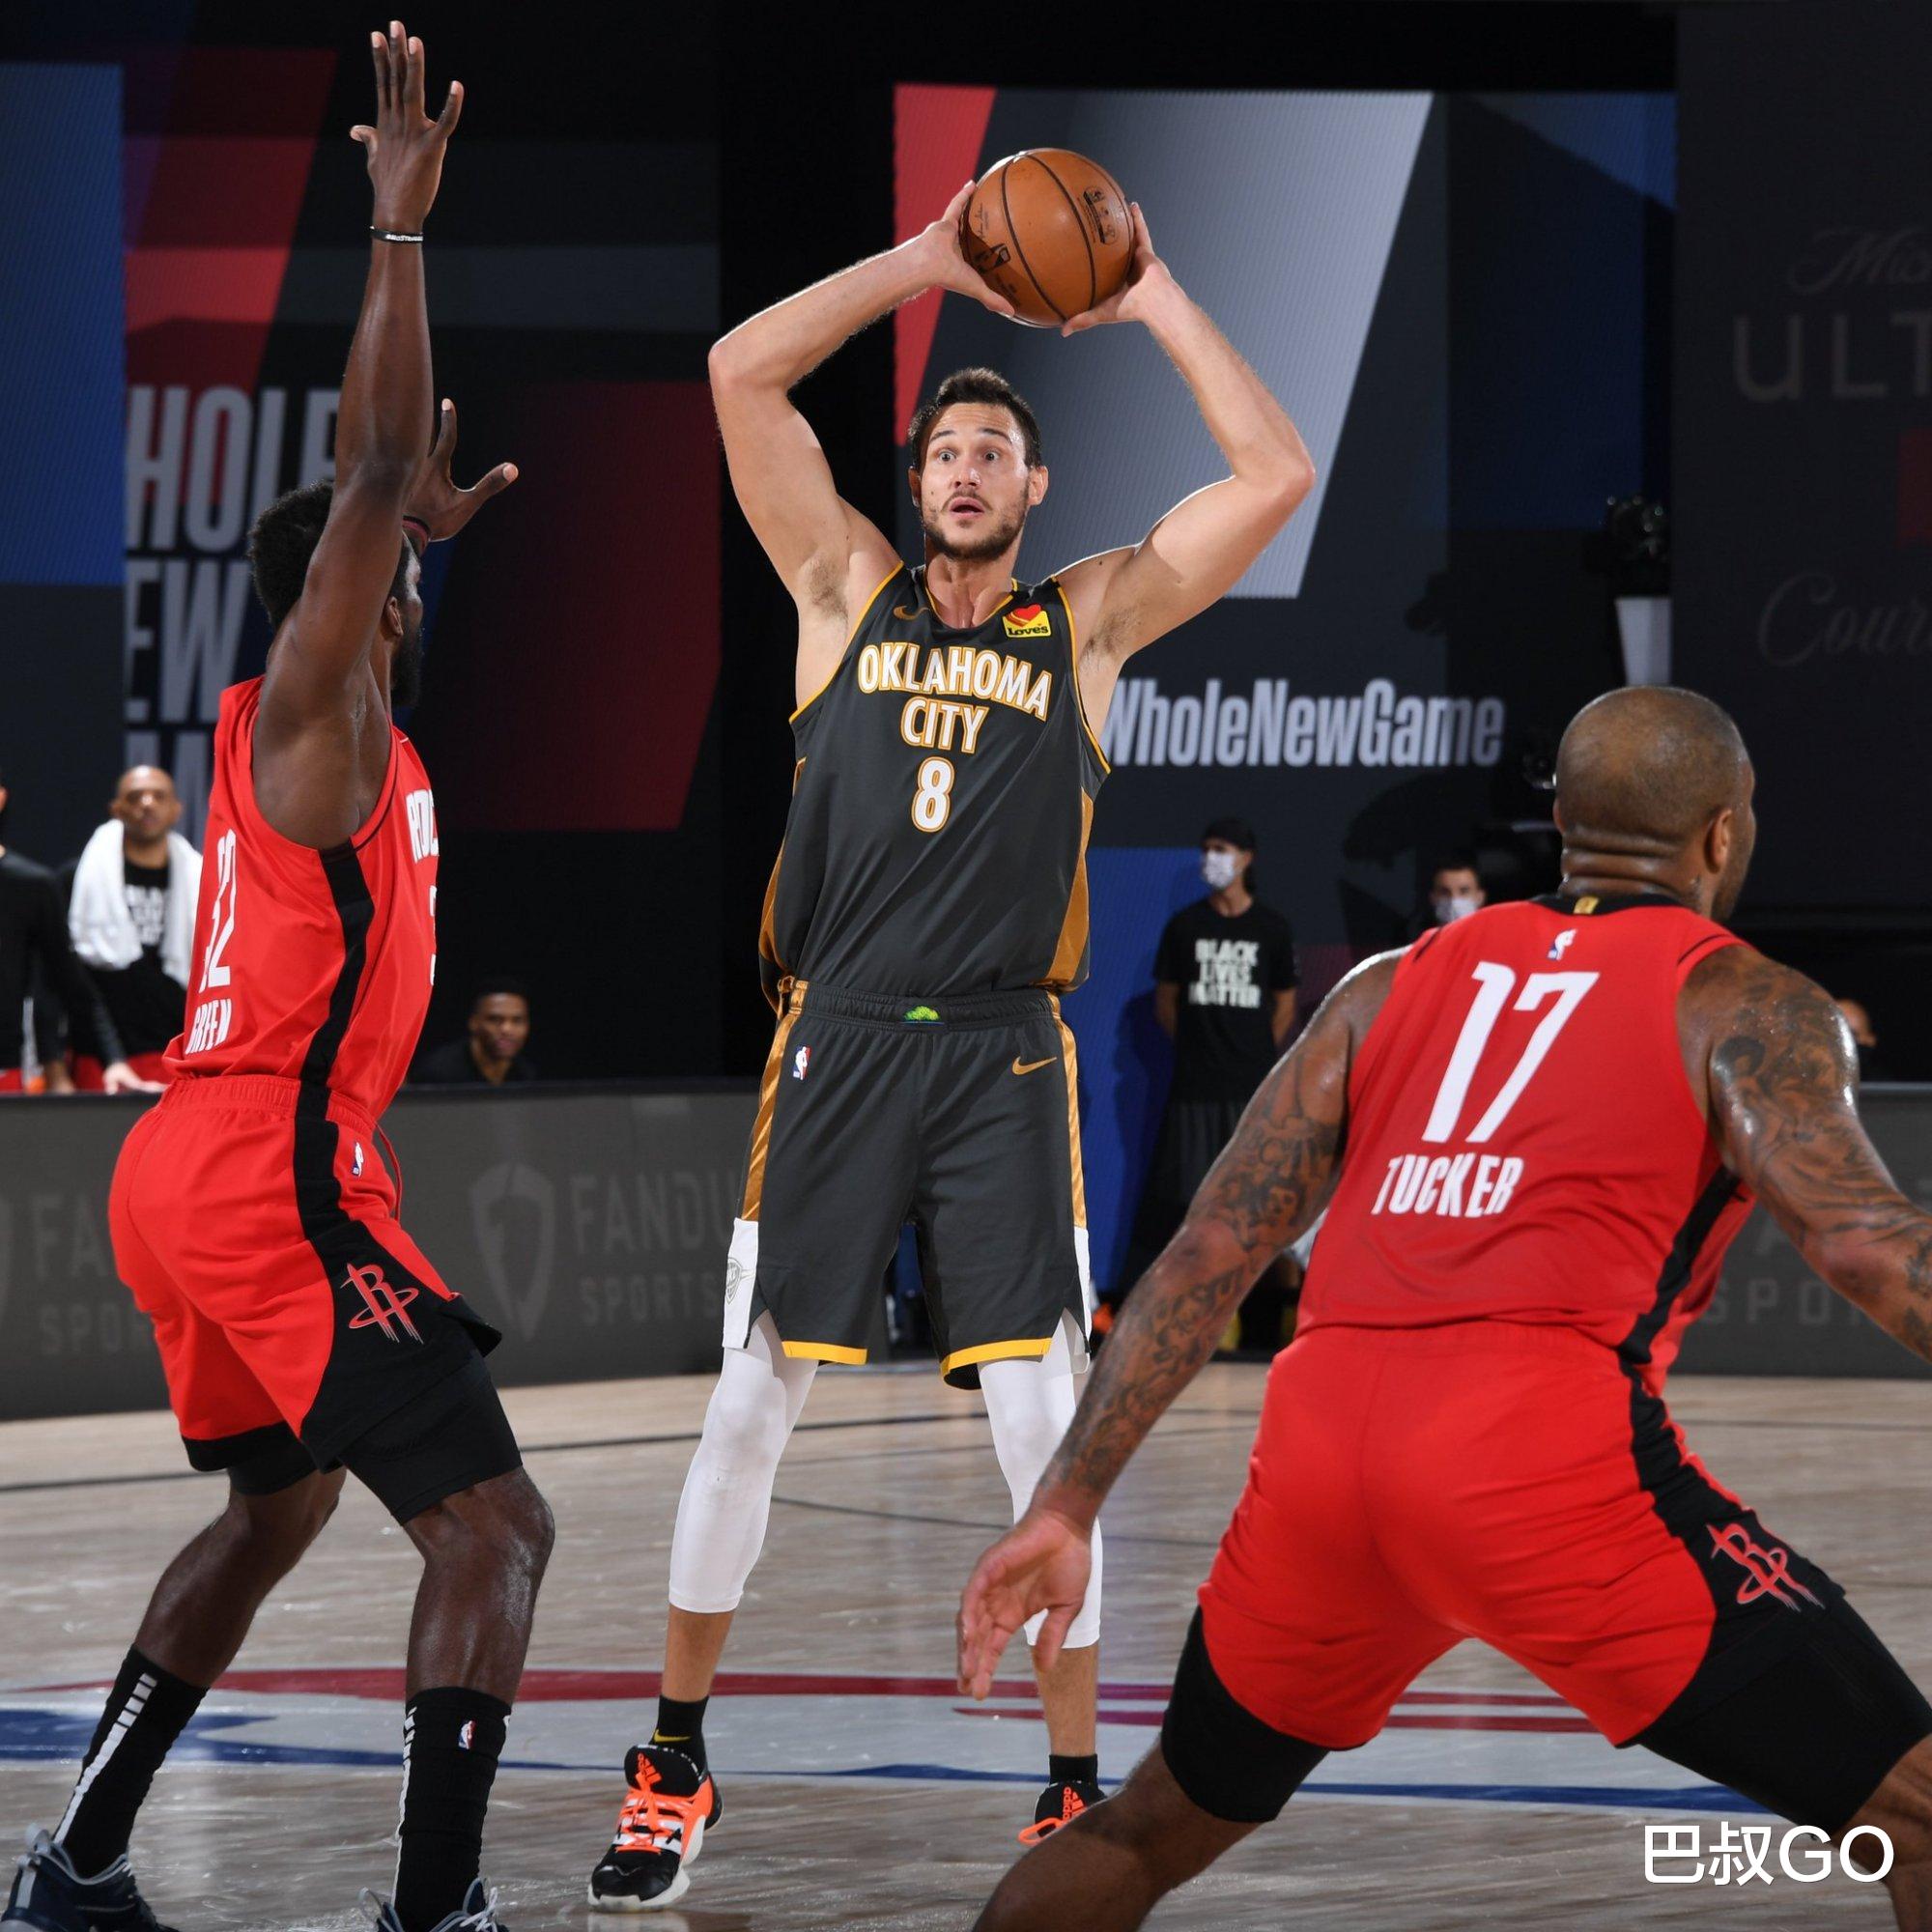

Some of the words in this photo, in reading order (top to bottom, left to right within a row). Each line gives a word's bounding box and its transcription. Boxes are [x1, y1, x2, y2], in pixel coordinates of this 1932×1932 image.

[1734, 309, 1932, 401] ULT
[1758, 571, 1932, 667] Cour
[858, 657, 1052, 723] OKLAHOMA
[900, 696, 989, 754] CITY
[911, 755, 954, 833] 8
[1195, 938, 1260, 967] BLACK
[1199, 963, 1252, 984] LIVES
[1188, 981, 1262, 1009] MATTER
[185, 998, 232, 1055] GREEN
[1421, 960, 1601, 1144] 17
[1371, 1152, 1524, 1218] TUCKER
[580, 1270, 720, 1327] SPORTS
[1702, 1277, 1861, 1326] SPO
[1063, 1786, 1072, 1822] adida
